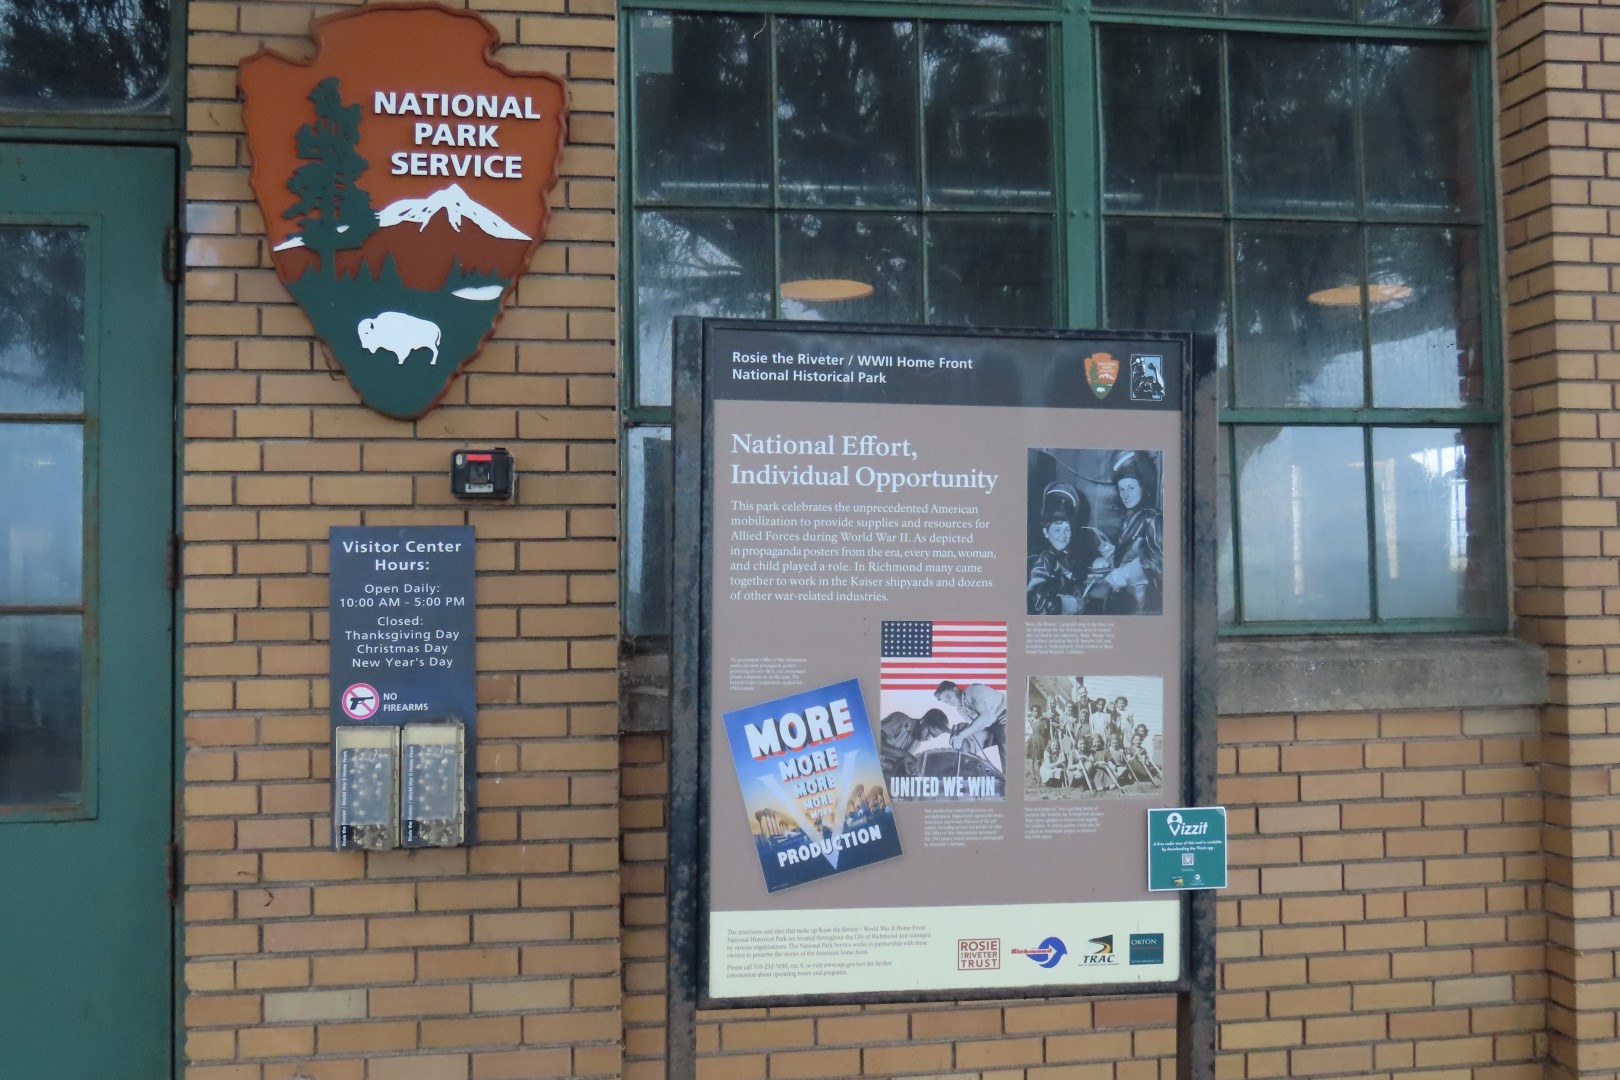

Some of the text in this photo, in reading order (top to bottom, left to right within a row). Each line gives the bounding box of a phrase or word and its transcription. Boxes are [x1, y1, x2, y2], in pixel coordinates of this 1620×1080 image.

[374, 91, 540, 120] NATIONAL
[414, 122, 499, 148] PARK
[390, 153, 523, 179] SERVICE
[732, 351, 973, 369] Rosie the Riveter / WWII Home Front
[733, 369, 886, 383] National Historical Park
[731, 433, 917, 460] National Effort,
[730, 463, 998, 494] Individual Opportunity
[730, 500, 978, 515] This park celebrates the unprecedented American
[730, 515, 798, 526] mobilization
[800, 518, 811, 526] to
[813, 517, 854, 529] provide
[856, 517, 899, 530] supplies
[901, 518, 921, 528] and
[975, 518, 990, 528] for
[730, 530, 974, 545] Allied Forces during World War II. As depicted
[342, 541, 461, 553] Visitor Center
[730, 545, 996, 560] in propaganda posters from the era, every man, woman,
[375, 559, 429, 570] Hours:
[730, 560, 751, 570] and
[753, 560, 779, 570] child
[782, 561, 817, 573] played
[828, 561, 851, 571] role.
[854, 561, 865, 571] In
[868, 562, 922, 572] Richmond
[925, 565, 953, 575] many
[364, 583, 439, 595] Open Daily:
[730, 575, 993, 589] together to work in the Kaiser shipyards and dozens
[340, 597, 374, 607] 10:00
[378, 597, 400, 607] AM
[414, 597, 441, 606] 5:00
[445, 597, 464, 606] PM
[730, 590, 889, 601] of other war-related industries.
[377, 616, 423, 626] Closed:
[344, 629, 459, 642] Thanksgiving Day
[356, 643, 448, 654] Christmas Day
[352, 657, 453, 668] New Year's Day
[383, 692, 397, 700] NO
[383, 703, 428, 711] FIREARMS
[744, 699, 854, 760] MORE
[778, 747, 838, 782] MORE
[794, 775, 836, 799] MORE
[890, 776, 996, 797] UNITED WE WIN
[804, 795, 833, 811] MORE
[1167, 813, 1208, 836] Vizzit
[777, 824, 882, 868] PRODUCTION
[961, 941, 997, 951] ROSIE
[961, 959, 997, 968] TRUST
[1083, 954, 1115, 963] TRAC
